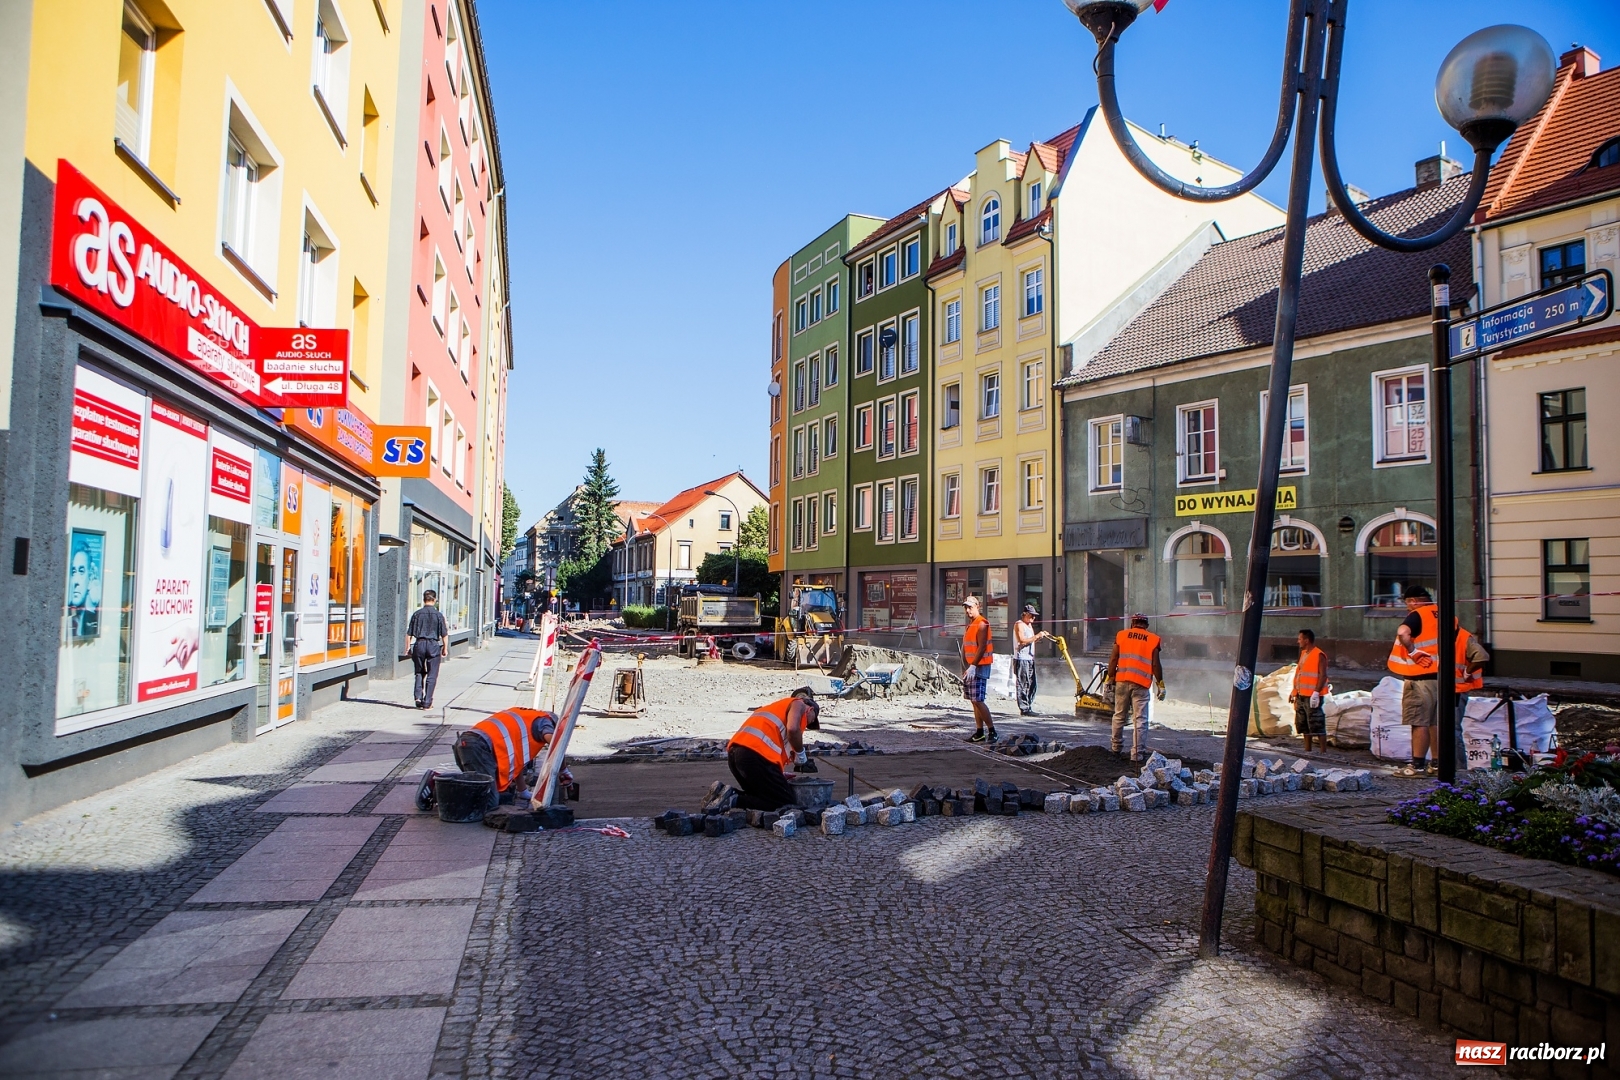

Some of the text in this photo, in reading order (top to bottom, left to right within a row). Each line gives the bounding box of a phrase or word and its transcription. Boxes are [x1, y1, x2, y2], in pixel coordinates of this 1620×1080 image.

[74, 197, 136, 308] as
[136, 243, 250, 355] AUDIO-SŁUCH
[1482, 305, 1534, 330] Informacja
[1545, 301, 1579, 320] 250 m
[291, 333, 317, 350] as
[1482, 321, 1536, 344] Turystyczna
[197, 337, 225, 371] aparaty
[226, 355, 256, 389] słuchowe
[275, 351, 332, 360] AUDIO-SŁUCH
[267, 361, 341, 372] badanie słuchu
[281, 382, 340, 393] ul. Długa 48
[1411, 404, 1425, 416] 32
[73, 404, 139, 438] ezpłatne testowanie
[72, 426, 102, 446] paratów
[1411, 428, 1425, 440] 25
[382, 436, 426, 466] STS
[1410, 440, 1424, 451] 97
[287, 483, 299, 514] STS
[1177, 490, 1295, 511] DO WYNAJIA
[155, 579, 191, 595] APARATY
[150, 599, 193, 616] SŁUCHOWE
[1128, 631, 1149, 642] BRUK
